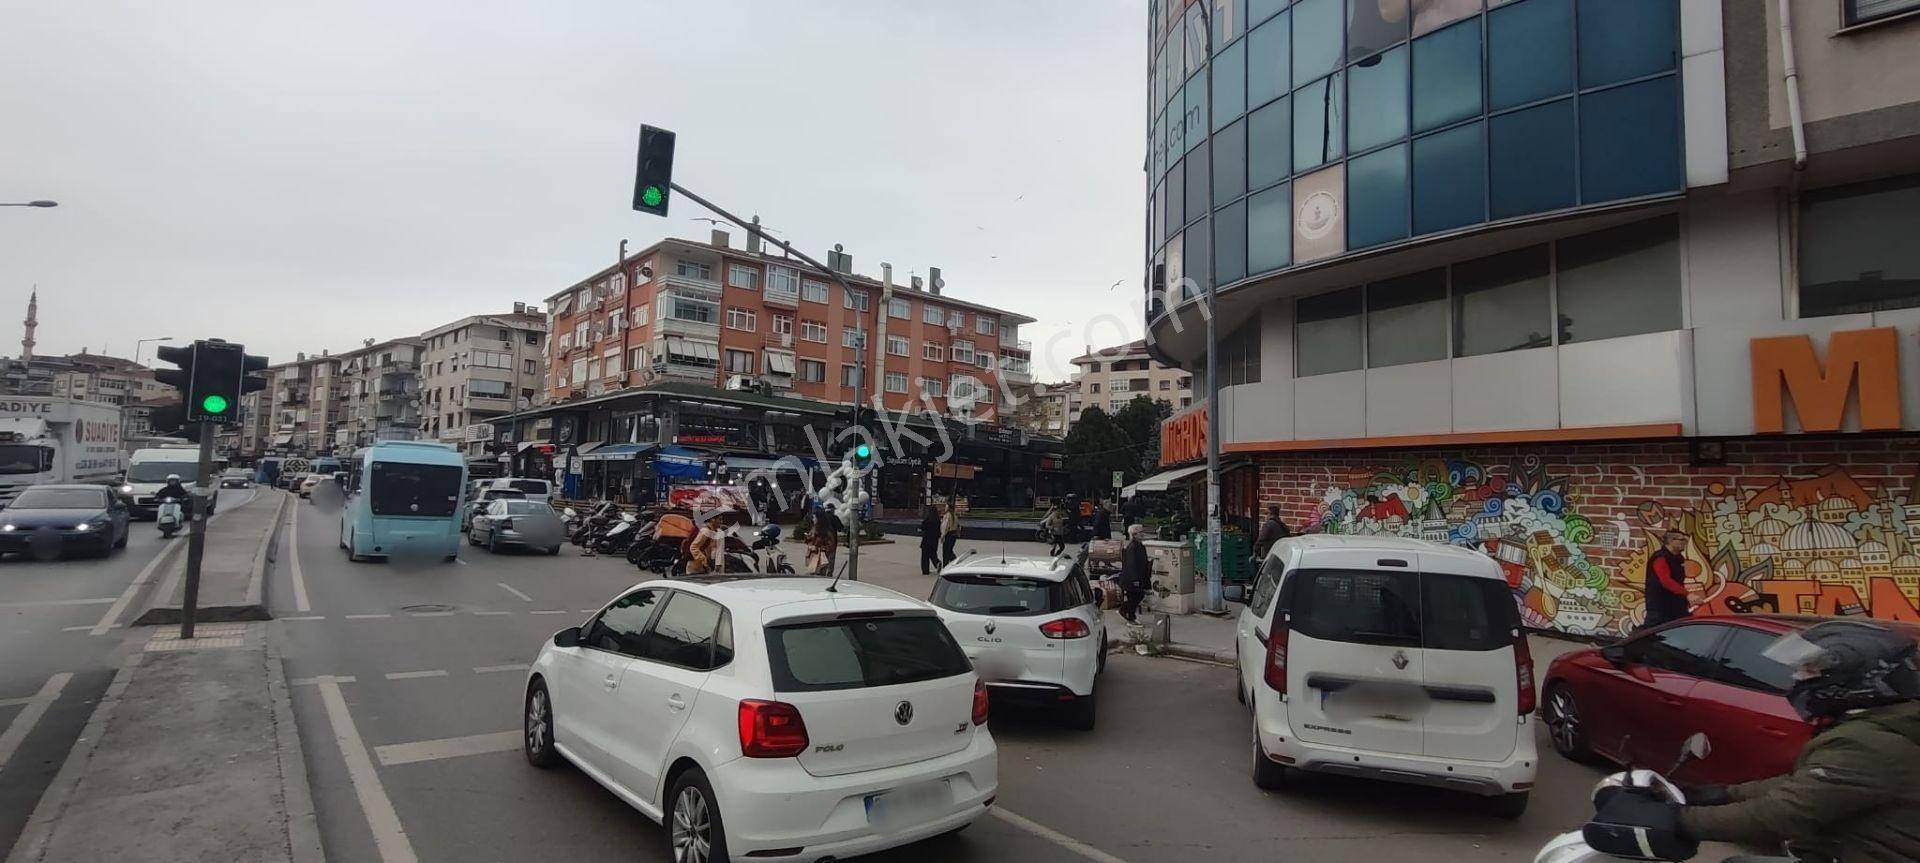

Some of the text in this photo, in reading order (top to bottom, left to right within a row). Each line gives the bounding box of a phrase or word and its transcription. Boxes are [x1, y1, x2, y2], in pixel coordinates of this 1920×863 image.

[1750, 326, 1903, 434] M
[1303, 723, 1352, 735] EXPRESS
[815, 743, 844, 753] POLO
